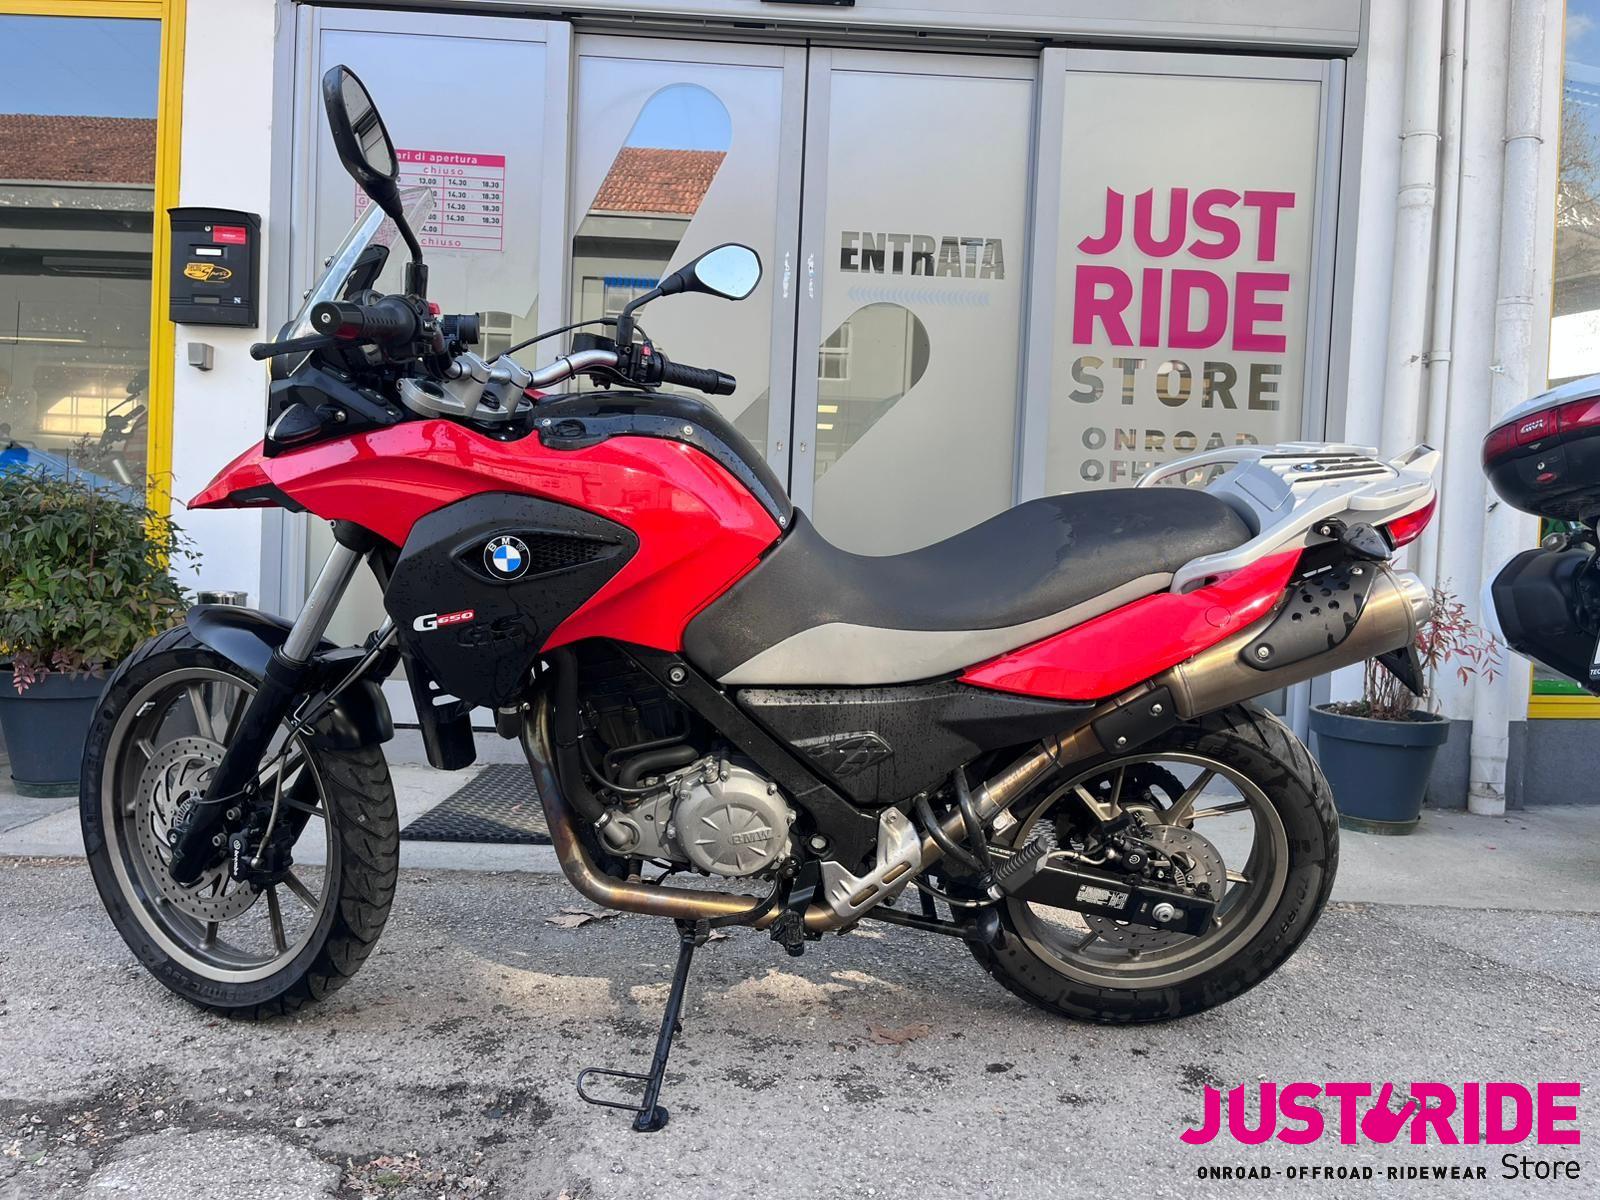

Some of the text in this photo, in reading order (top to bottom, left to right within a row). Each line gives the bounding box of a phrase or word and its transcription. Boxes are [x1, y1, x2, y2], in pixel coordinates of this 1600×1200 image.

[396, 151, 478, 165] ari di apertura
[423, 165, 464, 176] chiuso
[448, 178, 467, 187] 14.30
[482, 181, 499, 189] 18.30
[447, 191, 500, 200] 14.30 18.30
[447, 203, 500, 212] 14.30 18.30
[446, 214, 465, 222] 14.30
[1077, 186, 1296, 262] JUST
[421, 225, 438, 233] 4.00
[421, 238, 462, 247] chiuso
[840, 230, 1005, 280] ENTRATA
[1072, 265, 1290, 353] RIDE
[1068, 356, 1282, 411] STORE
[1082, 427, 1259, 452] ONROAD
[731, 829, 770, 845] BMW
